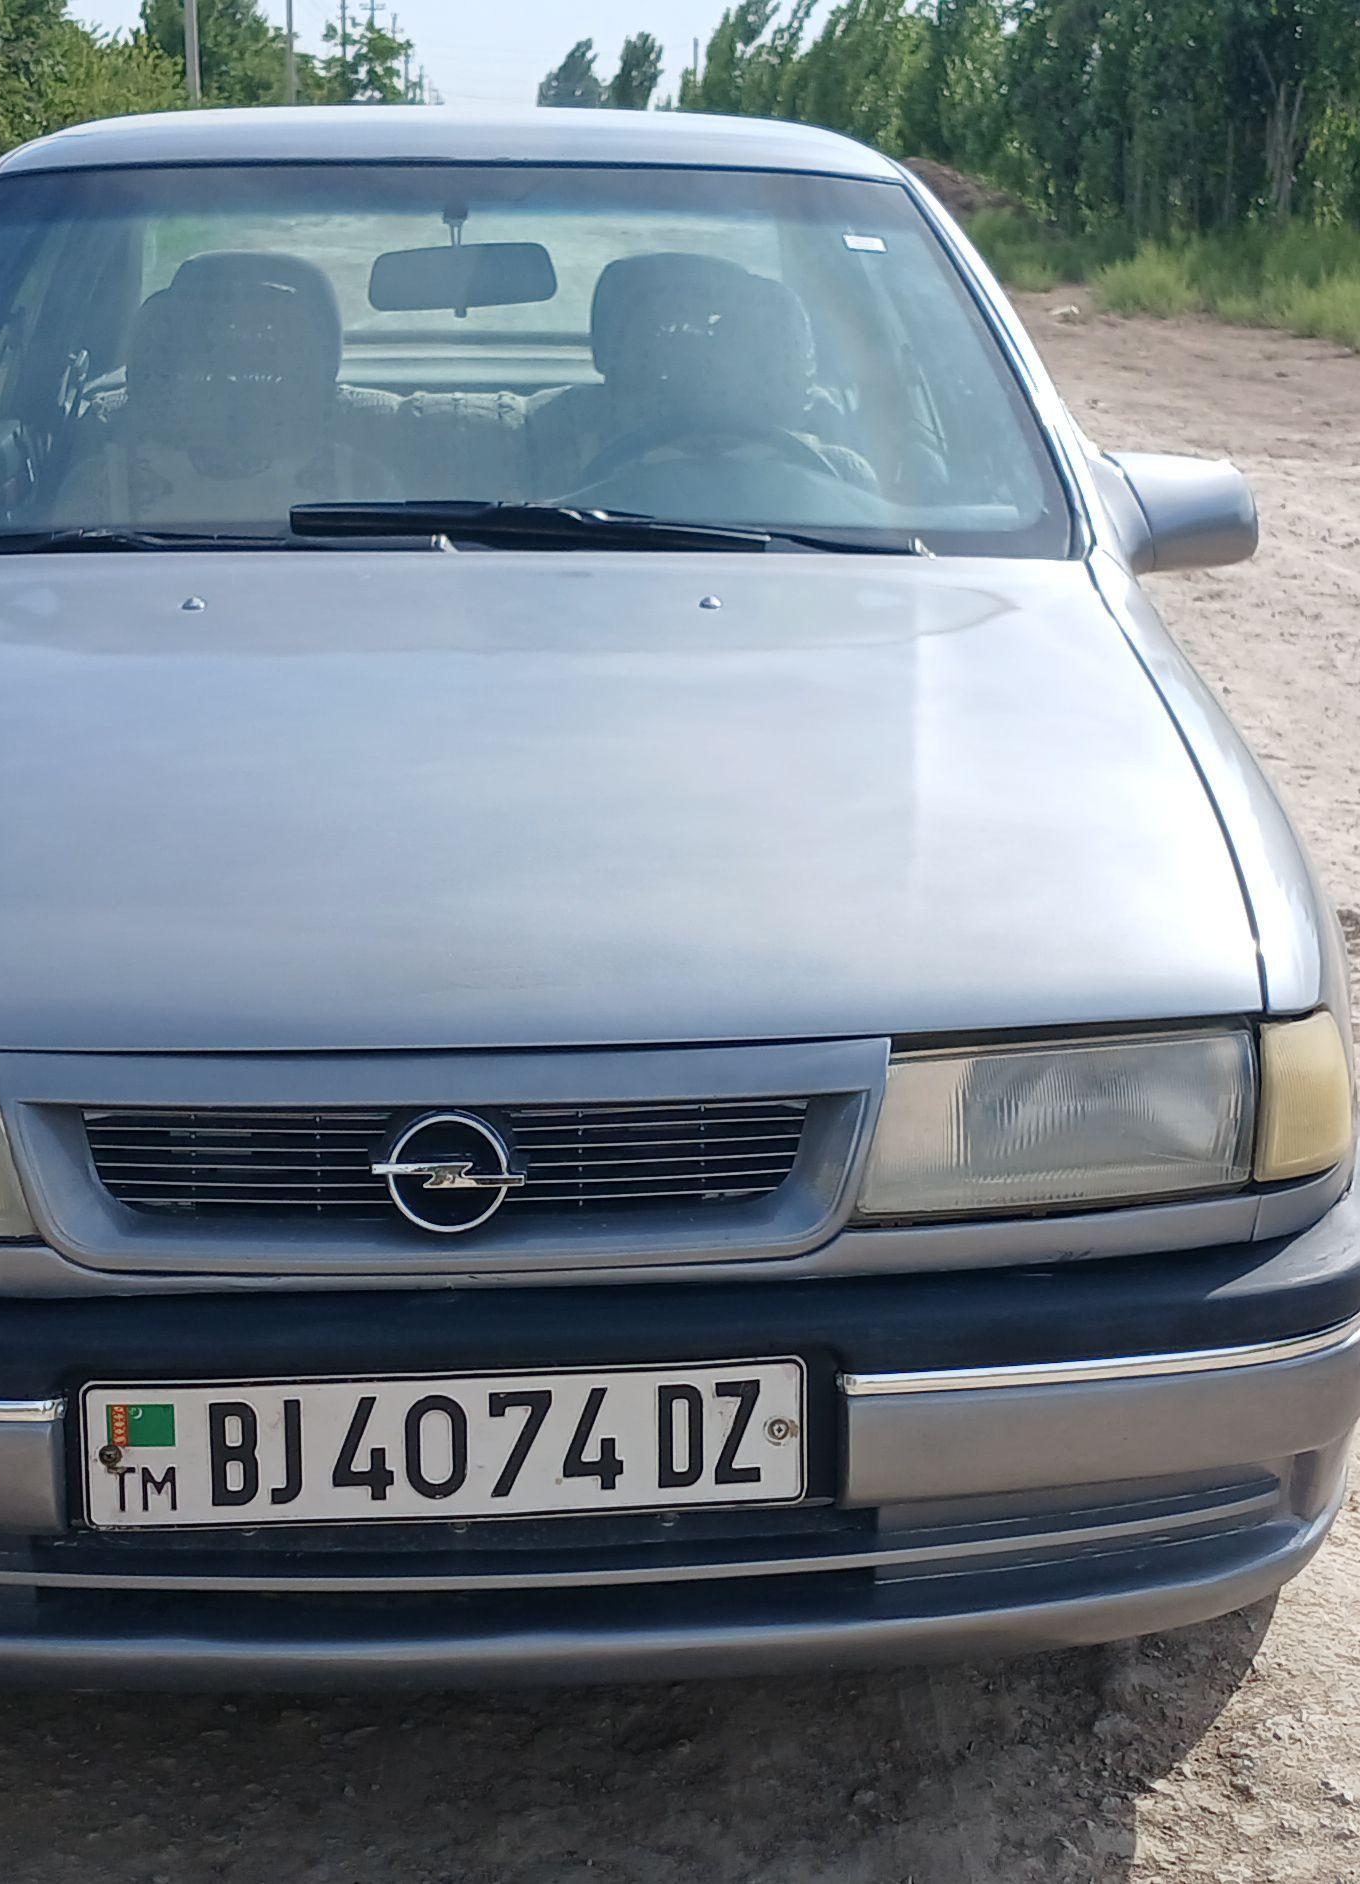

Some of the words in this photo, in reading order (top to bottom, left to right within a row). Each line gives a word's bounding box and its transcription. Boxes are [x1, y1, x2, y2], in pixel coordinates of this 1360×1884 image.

[208, 1399, 302, 1506] BJ
[331, 1386, 625, 1501] 4074
[656, 1379, 762, 1489] DZ
[114, 1465, 178, 1513] TM
